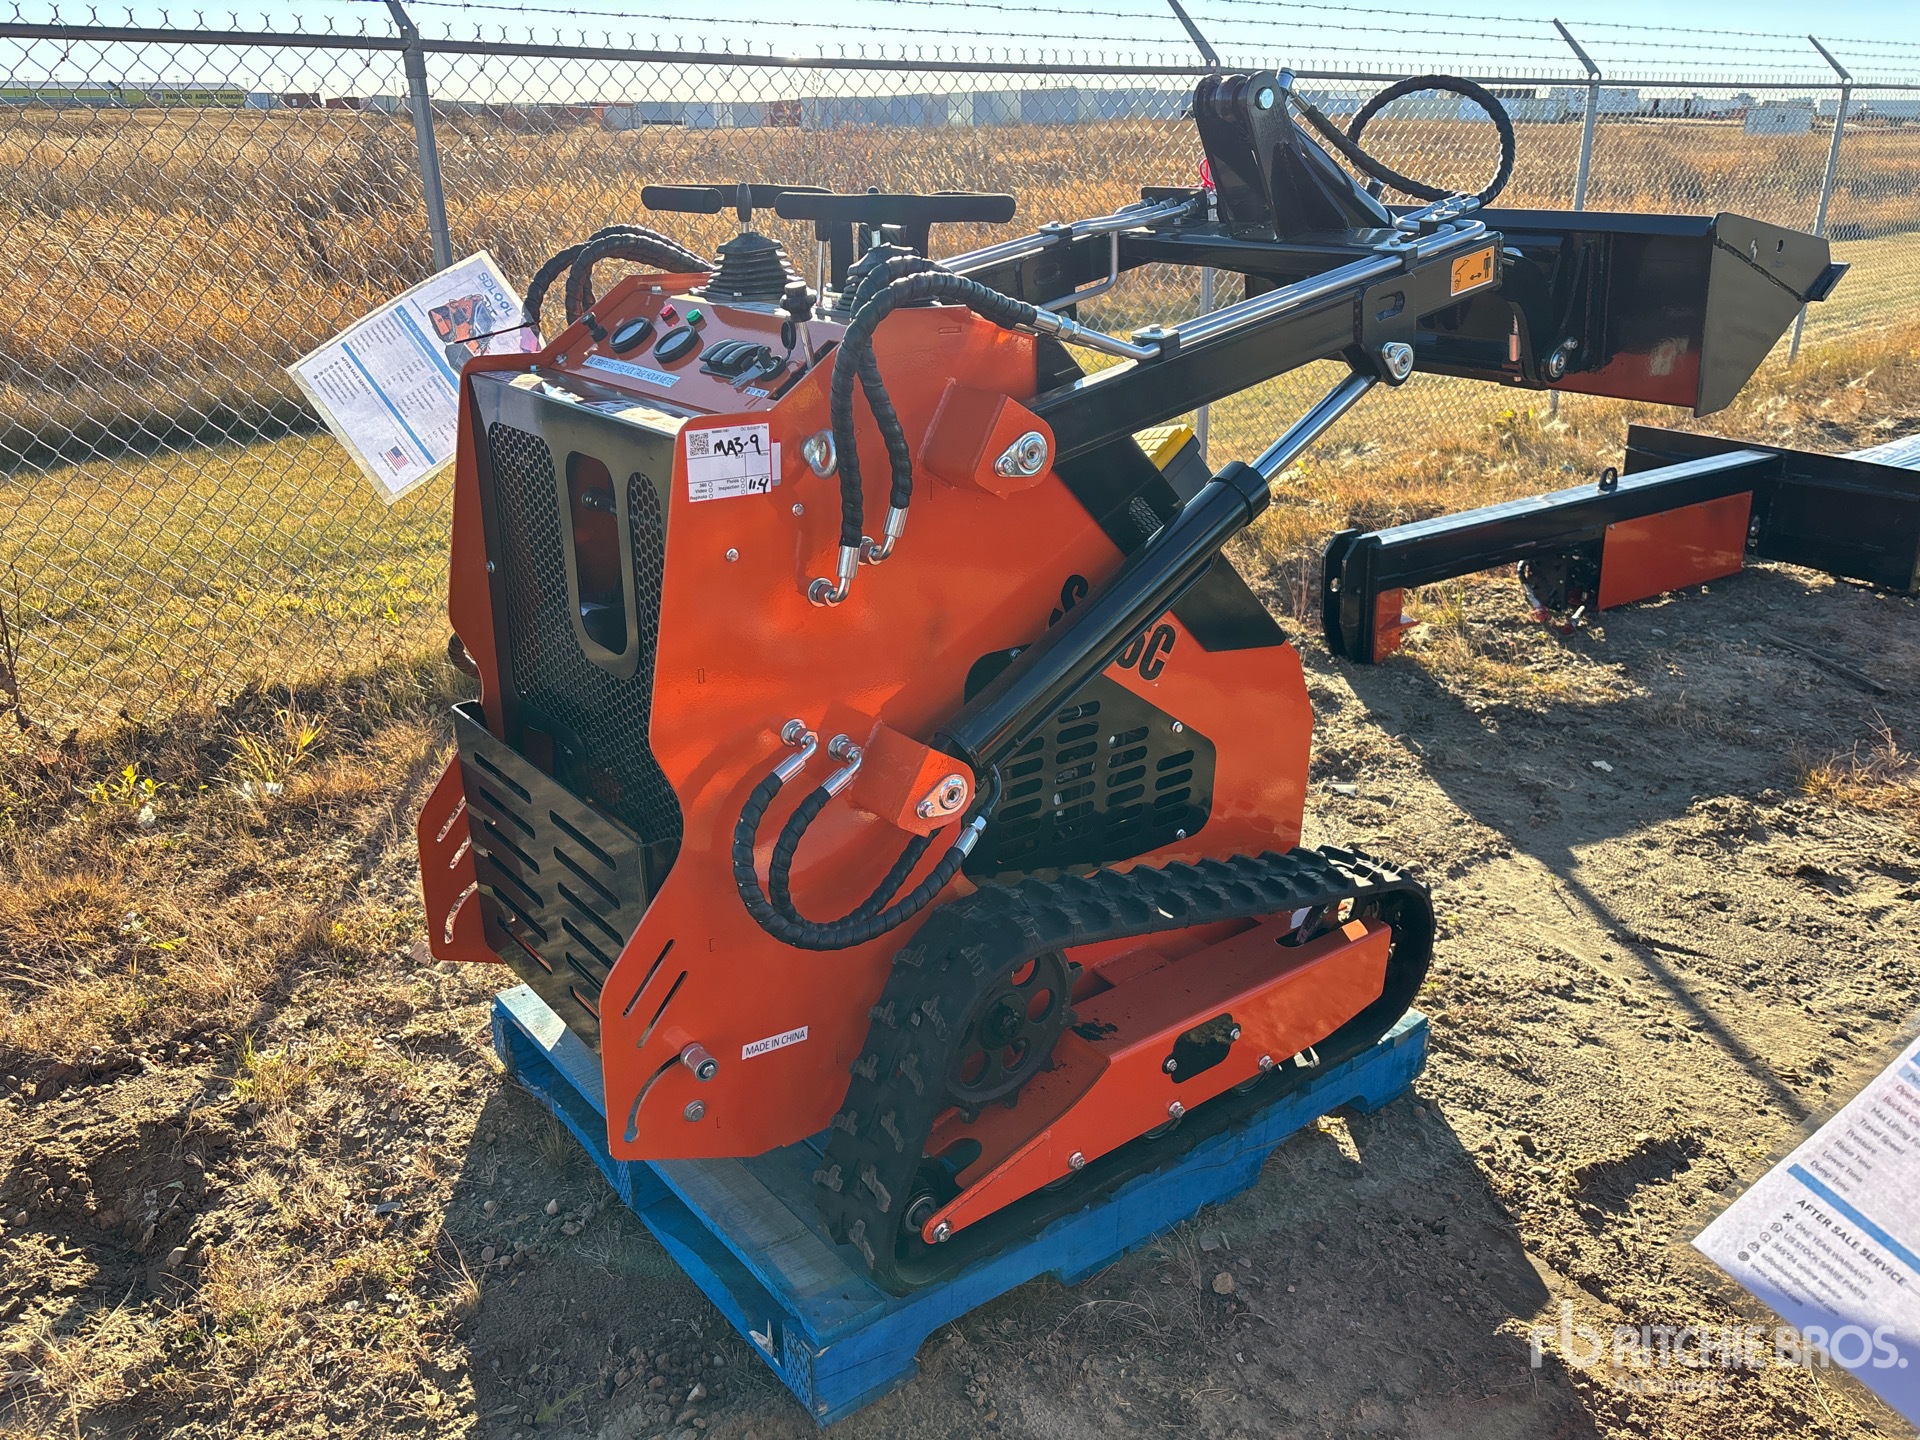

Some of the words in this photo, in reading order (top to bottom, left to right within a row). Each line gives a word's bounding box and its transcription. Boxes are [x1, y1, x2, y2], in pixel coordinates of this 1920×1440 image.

[478, 272, 513, 317] SDLOOL
[340, 356, 351, 369] AFTER
[350, 369, 358, 378] SALE
[357, 378, 371, 395] SERVICE
[714, 434, 761, 456] MA3-9
[746, 1041, 769, 1056] MADE
[771, 1038, 780, 1048] IN
[781, 1030, 805, 1045] CHINA
[1871, 1107, 1887, 1121] Max
[1859, 1118, 1883, 1140] Travel
[1834, 1139, 1854, 1157] Raise
[1846, 1129, 1878, 1155] Pressure
[1810, 1160, 1832, 1179] Dump
[1822, 1150, 1844, 1169] Lower
[1794, 1222, 1811, 1237] ONE
[1812, 1237, 1831, 1253] YEAR
[1796, 1198, 1831, 1227] AFTER
[1831, 1225, 1859, 1249] SALE
[1860, 1248, 1907, 1286] SERVICE
